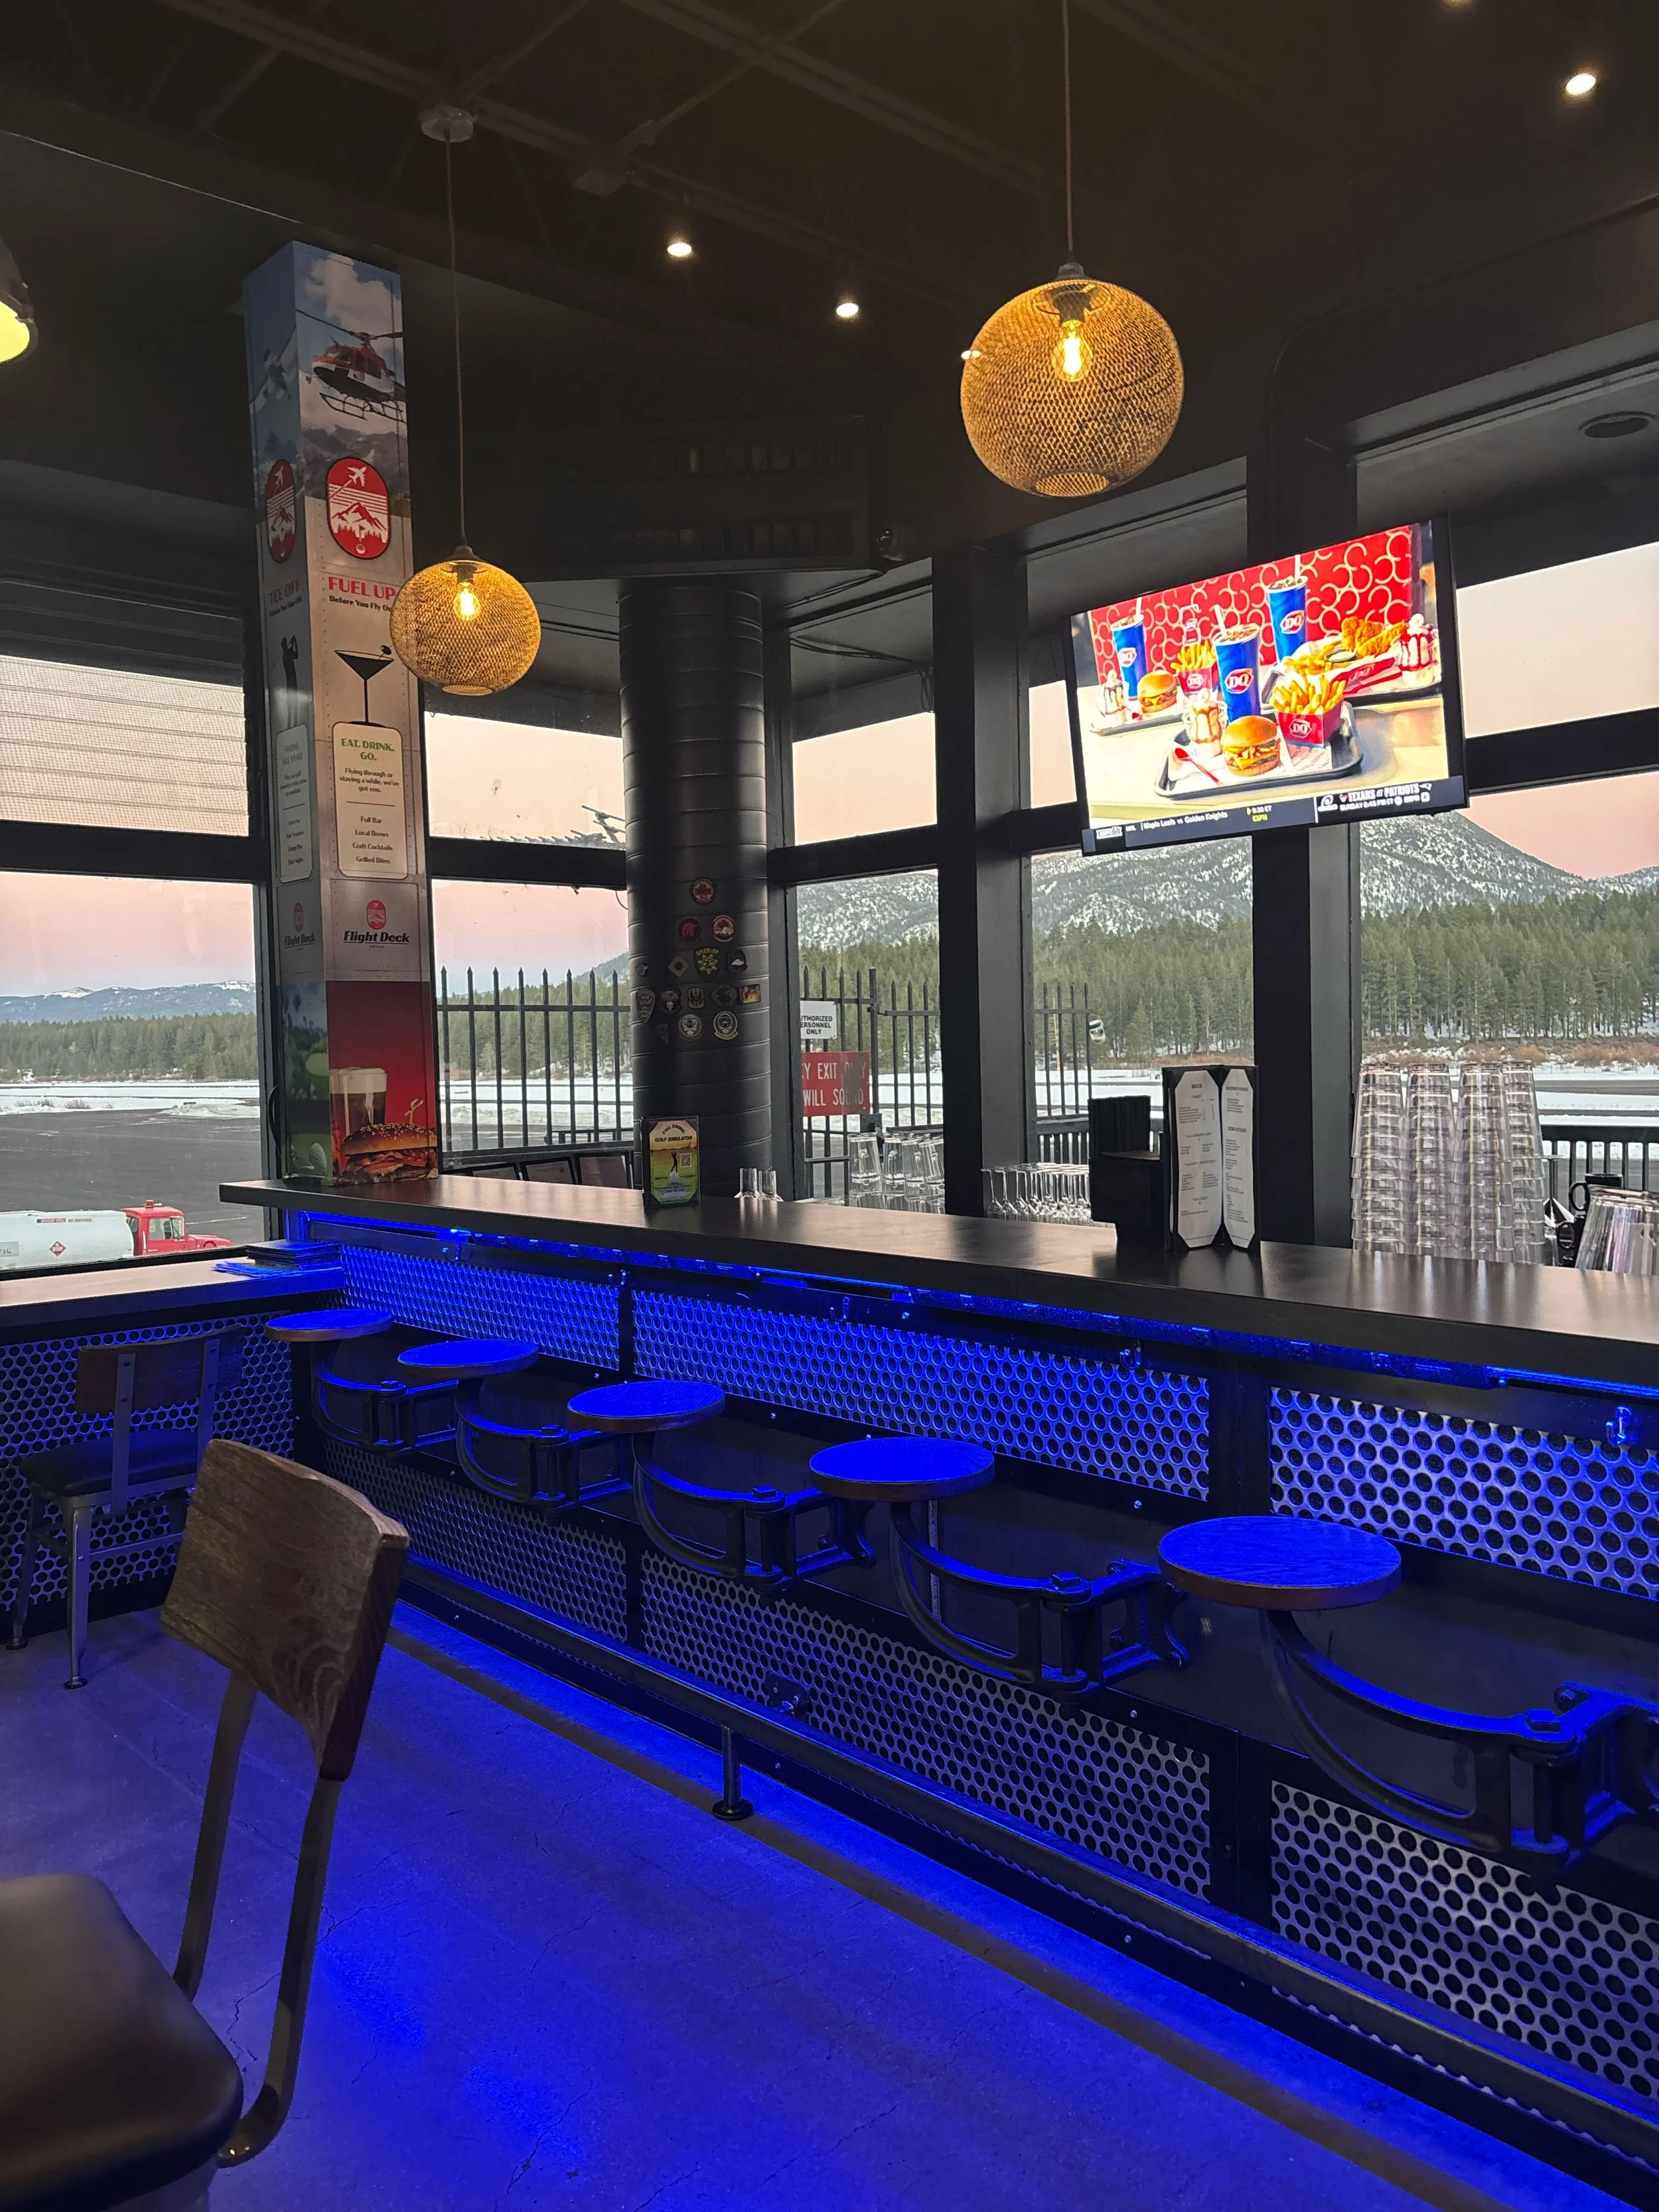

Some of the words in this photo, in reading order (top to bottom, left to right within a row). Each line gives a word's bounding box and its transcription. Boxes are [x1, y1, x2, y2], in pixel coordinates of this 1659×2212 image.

[328, 576, 370, 597] FUEL
[373, 585, 396, 600] UP
[329, 595, 353, 605] Before
[370, 602, 380, 611] Fly
[1285, 616, 1303, 628] DQ
[1354, 668, 1370, 678] DQ
[1229, 675, 1249, 688] DQ
[1294, 723, 1307, 733] DQ
[341, 738, 361, 748] EAT.
[362, 741, 394, 751] DRINK.
[360, 752, 377, 761] GO.
[345, 767, 362, 776] Flying
[1348, 789, 1376, 802] TEXANS
[1384, 783, 1419, 798] PATRIOTS
[1340, 801, 1363, 811] SUNDAY
[1144, 821, 1160, 830] Maple
[1205, 812, 1228, 820] Knights
[285, 934, 301, 946] Flight
[301, 932, 315, 943] Deck
[344, 931, 377, 943] Flight
[380, 932, 409, 942] Deck
[695, 948, 719, 956] SHERIFF
[818, 1063, 837, 1080] EXIT
[803, 1089, 826, 1106] WILL
[662, 1126, 672, 1135] FULL
